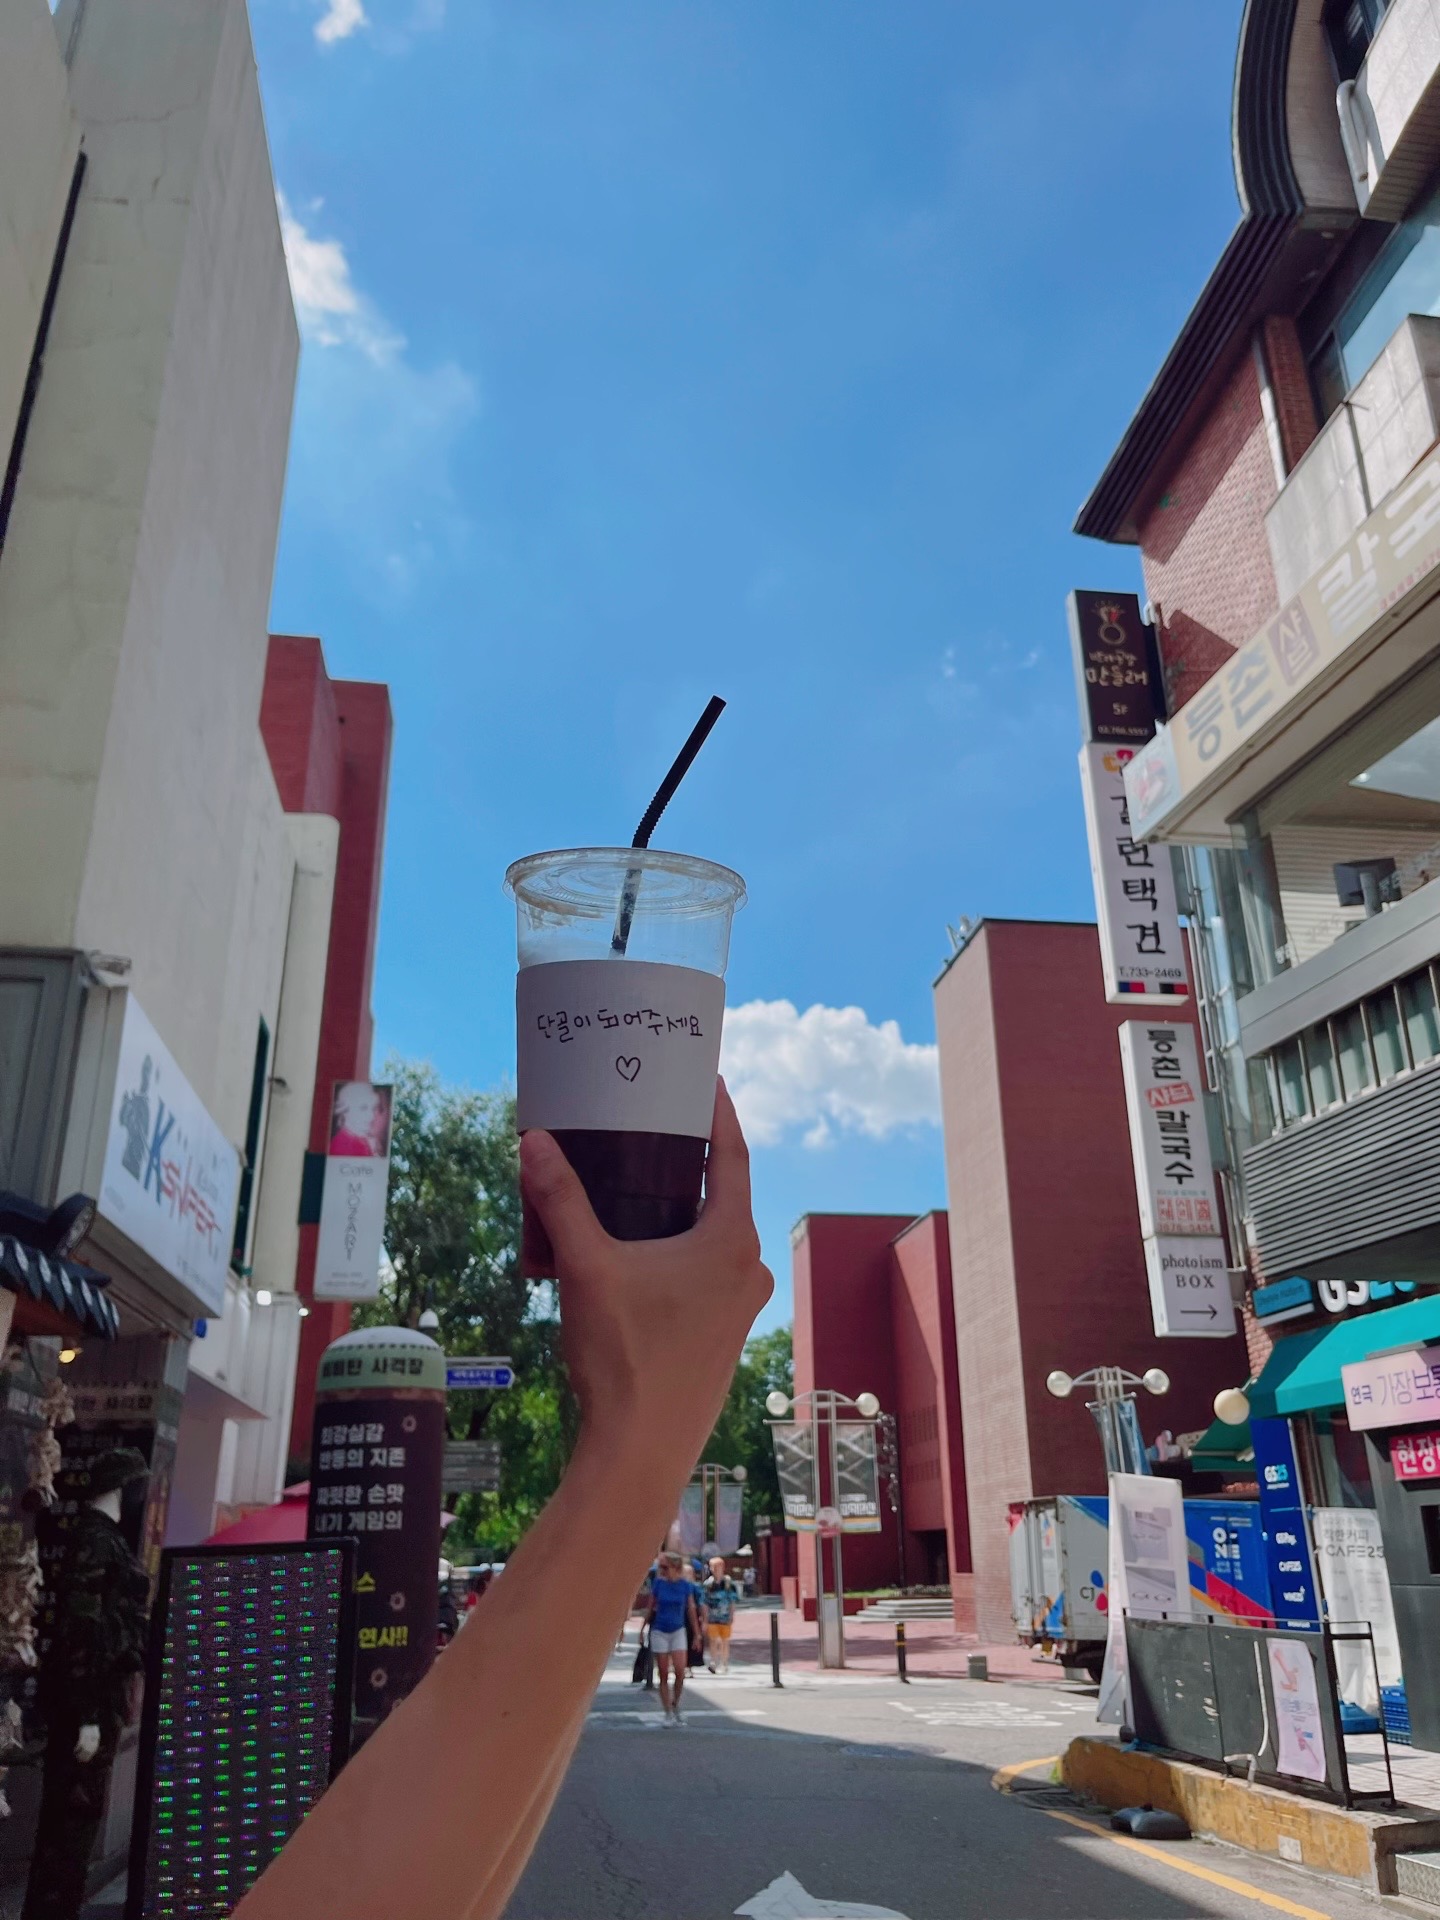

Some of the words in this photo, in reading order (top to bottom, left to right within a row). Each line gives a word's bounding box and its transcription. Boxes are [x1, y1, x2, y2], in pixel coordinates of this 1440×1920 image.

[1184, 641, 1276, 763] 등촌
[537, 1010, 591, 1044] 단골이
[597, 1008, 704, 1037] 되어주세요
[1155, 1110, 1195, 1186] 칼국수
[343, 1181, 362, 1262] MOZART
[1161, 1253, 1224, 1272] photoism
[1175, 1274, 1216, 1290] BOX
[371, 1356, 424, 1376] 사격장
[1351, 1384, 1373, 1405] 연극
[1376, 1370, 1412, 1407] 가장
[318, 1449, 364, 1470] 반동의
[369, 1447, 406, 1468] 지존
[1396, 1436, 1440, 1474] 현장
[367, 1483, 405, 1504] 손맛
[314, 1512, 343, 1532] 내기
[349, 1510, 404, 1532] 게임의
[1325, 1544, 1386, 1559] CAFE25
[352, 1571, 377, 1594] 스
[1079, 1586, 1095, 1602] CJ
[358, 1625, 409, 1649] 연사!!
